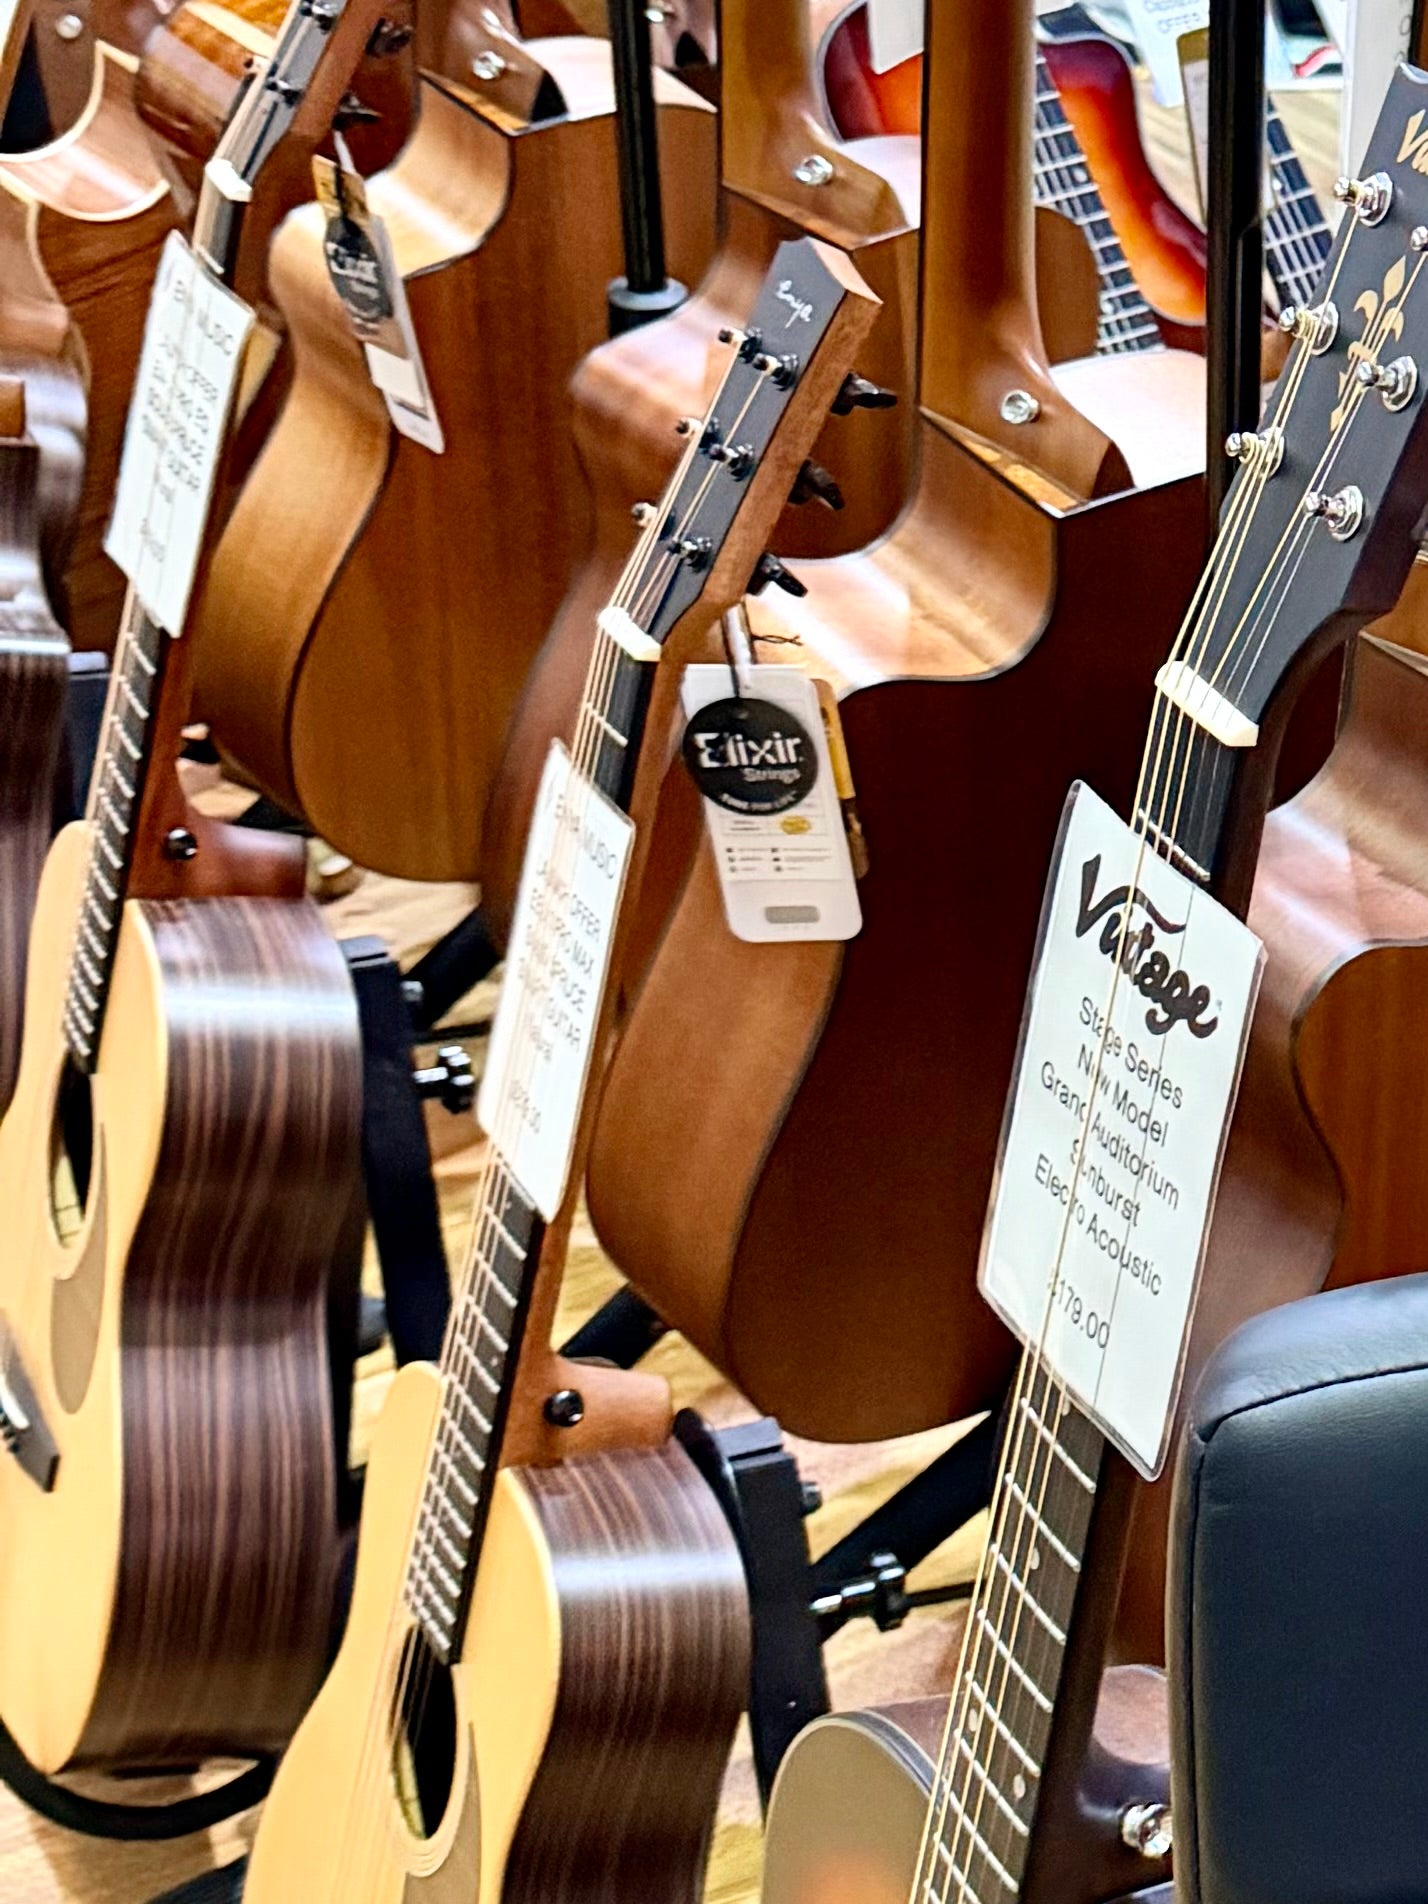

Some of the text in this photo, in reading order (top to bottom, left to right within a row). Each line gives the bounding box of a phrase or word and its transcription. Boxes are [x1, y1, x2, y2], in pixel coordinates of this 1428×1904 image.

[694, 731, 803, 769] Elixir
[1076, 853, 1219, 1039] Vintage
[1111, 1079, 1170, 1148] Model
[1124, 1042, 1184, 1110] Series
[1091, 1111, 1181, 1211] Auditorium
[1086, 1212, 1163, 1297] Acoustic
